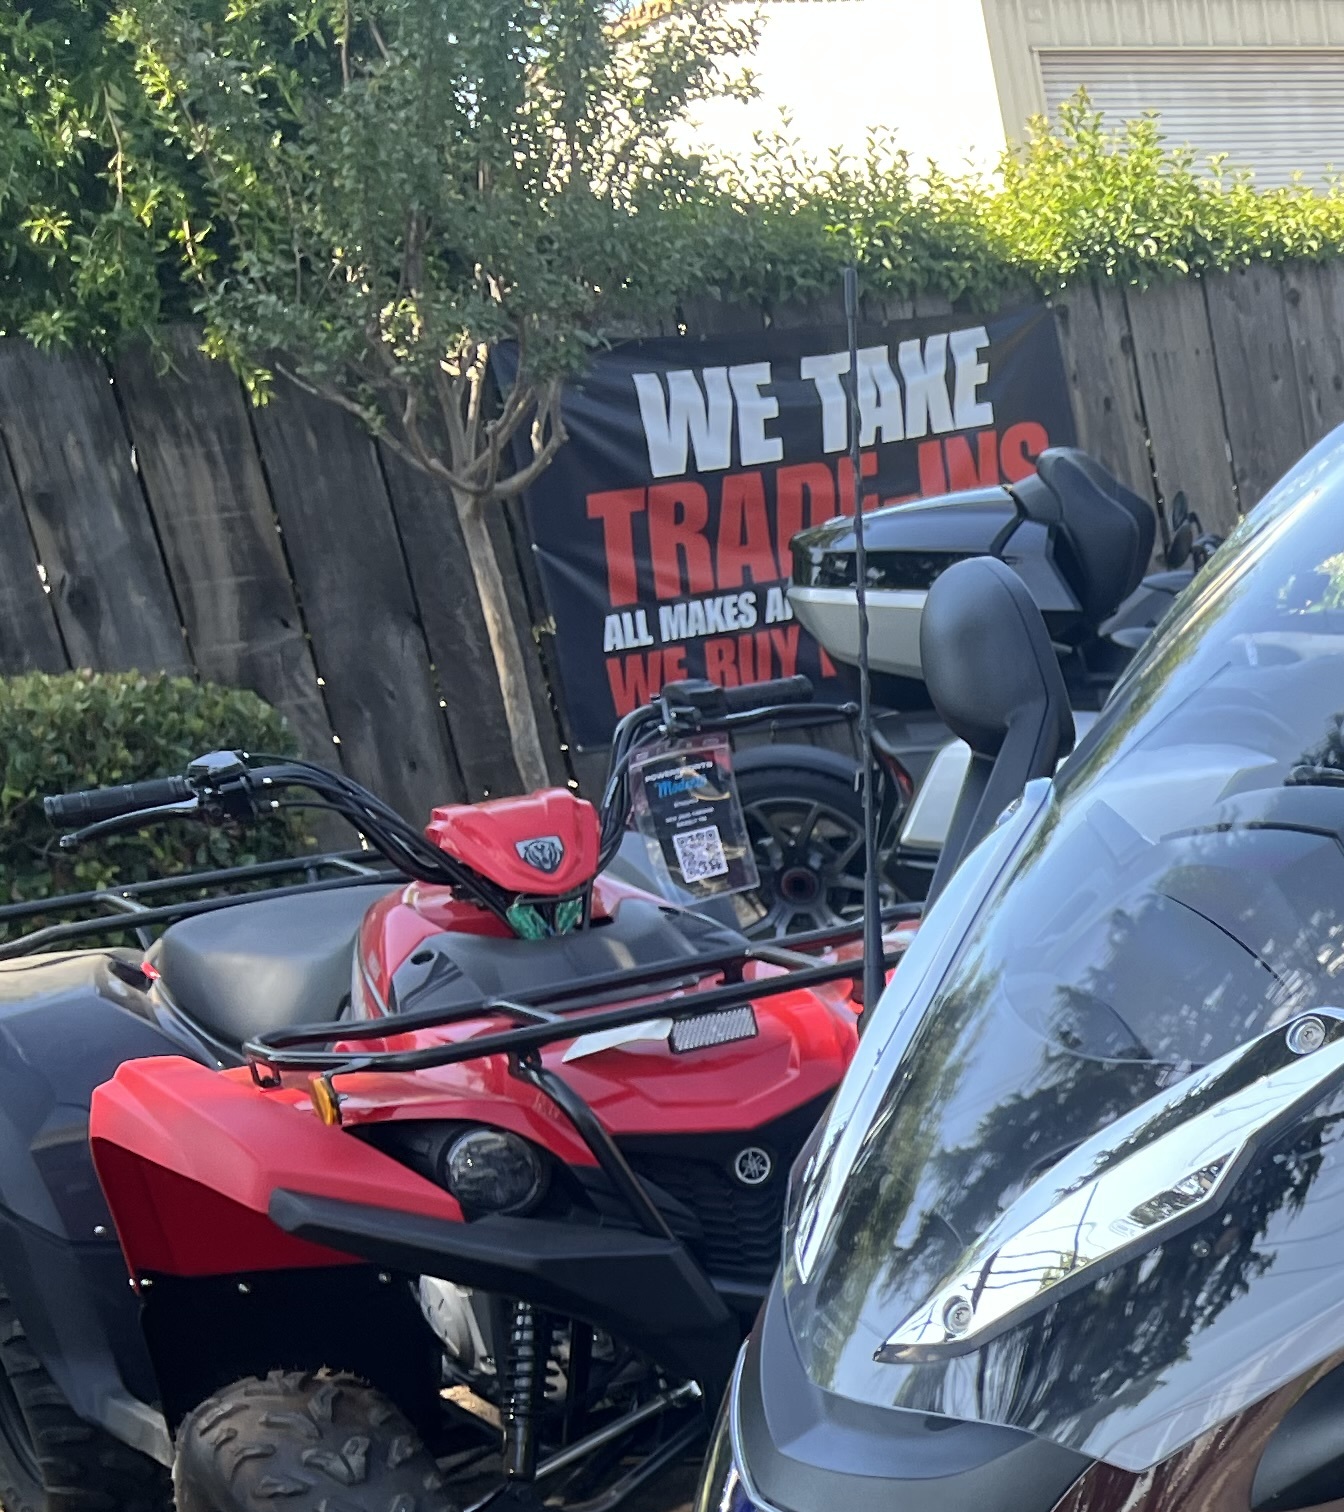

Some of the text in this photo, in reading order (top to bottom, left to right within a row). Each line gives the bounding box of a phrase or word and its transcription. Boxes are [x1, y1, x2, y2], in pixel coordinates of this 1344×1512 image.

[633, 326, 994, 478] WE TAKE
[604, 609, 654, 652] ALL
[658, 591, 757, 642] MAKES
[606, 646, 688, 717] WE
[705, 624, 800, 690] BUY
